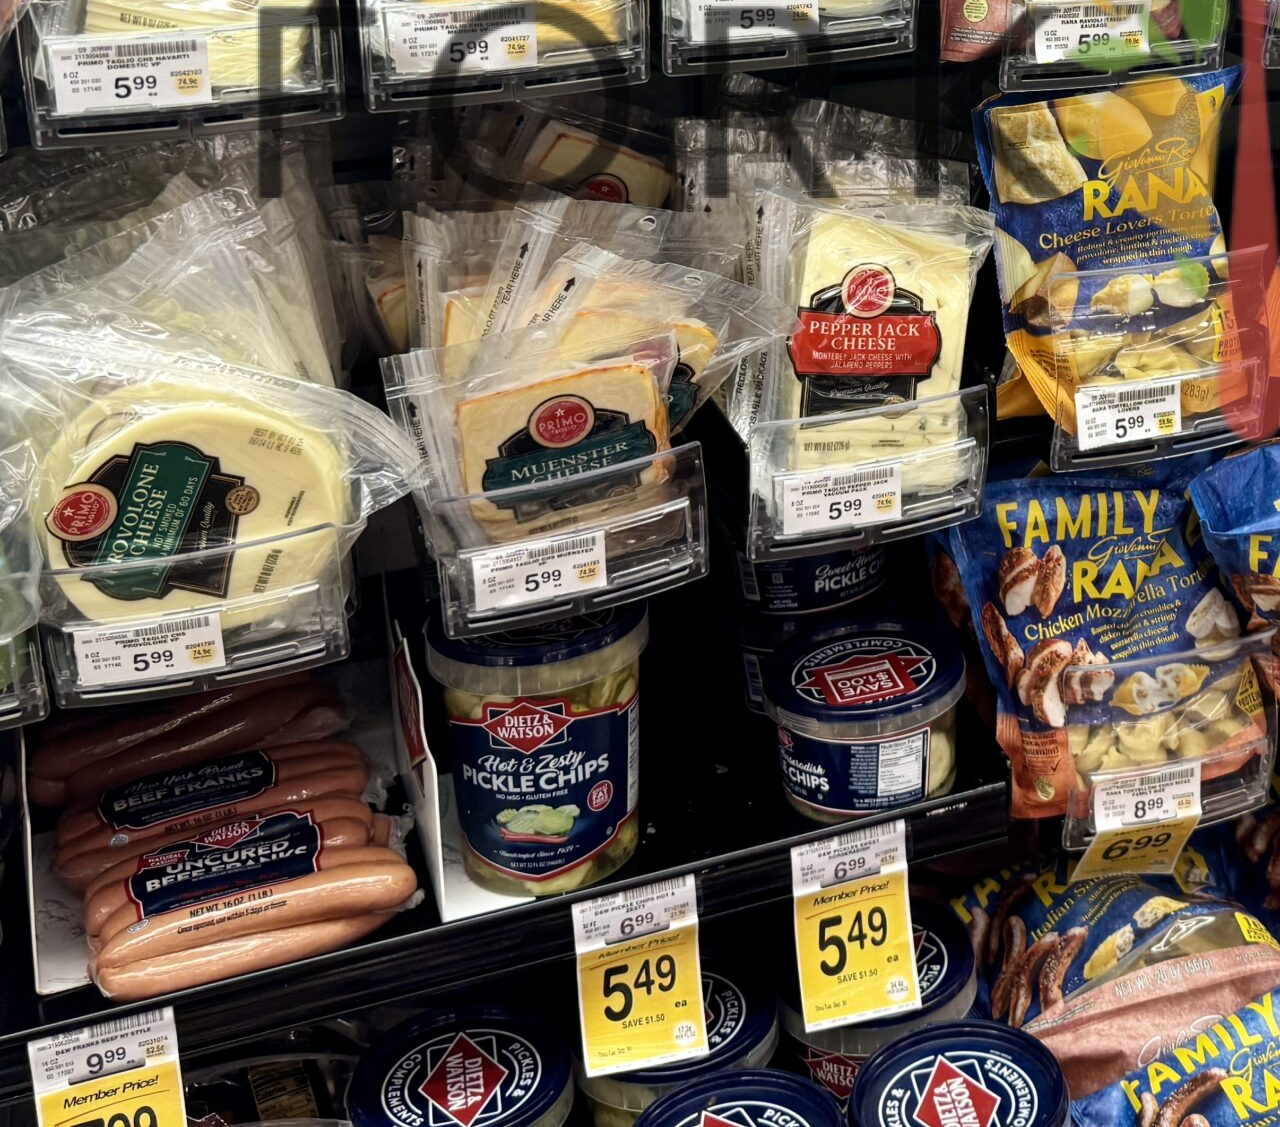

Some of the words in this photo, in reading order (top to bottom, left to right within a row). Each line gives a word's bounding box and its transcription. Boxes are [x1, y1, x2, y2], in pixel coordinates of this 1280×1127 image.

[1083, 165, 1208, 219] RANA
[810, 321, 871, 336] PEPPER
[877, 322, 919, 336] JACK
[831, 336, 896, 351] CHEESE
[511, 442, 629, 481] MUENSTER
[996, 490, 1158, 549] FAMILY
[1025, 610, 1082, 642] Chicken
[498, 724, 554, 739] WATSON
[504, 714, 540, 727] DIETZ
[463, 765, 536, 793] PICKLE
[540, 753, 609, 790] CHIPS
[813, 888, 859, 906] Member
[862, 881, 889, 898] Price!
[675, 999, 687, 1008] ea
[622, 1018, 642, 1029] SAVE
[644, 1014, 665, 1024] $1.50
[63, 1089, 116, 1109] Member
[118, 1076, 159, 1097] Price!
